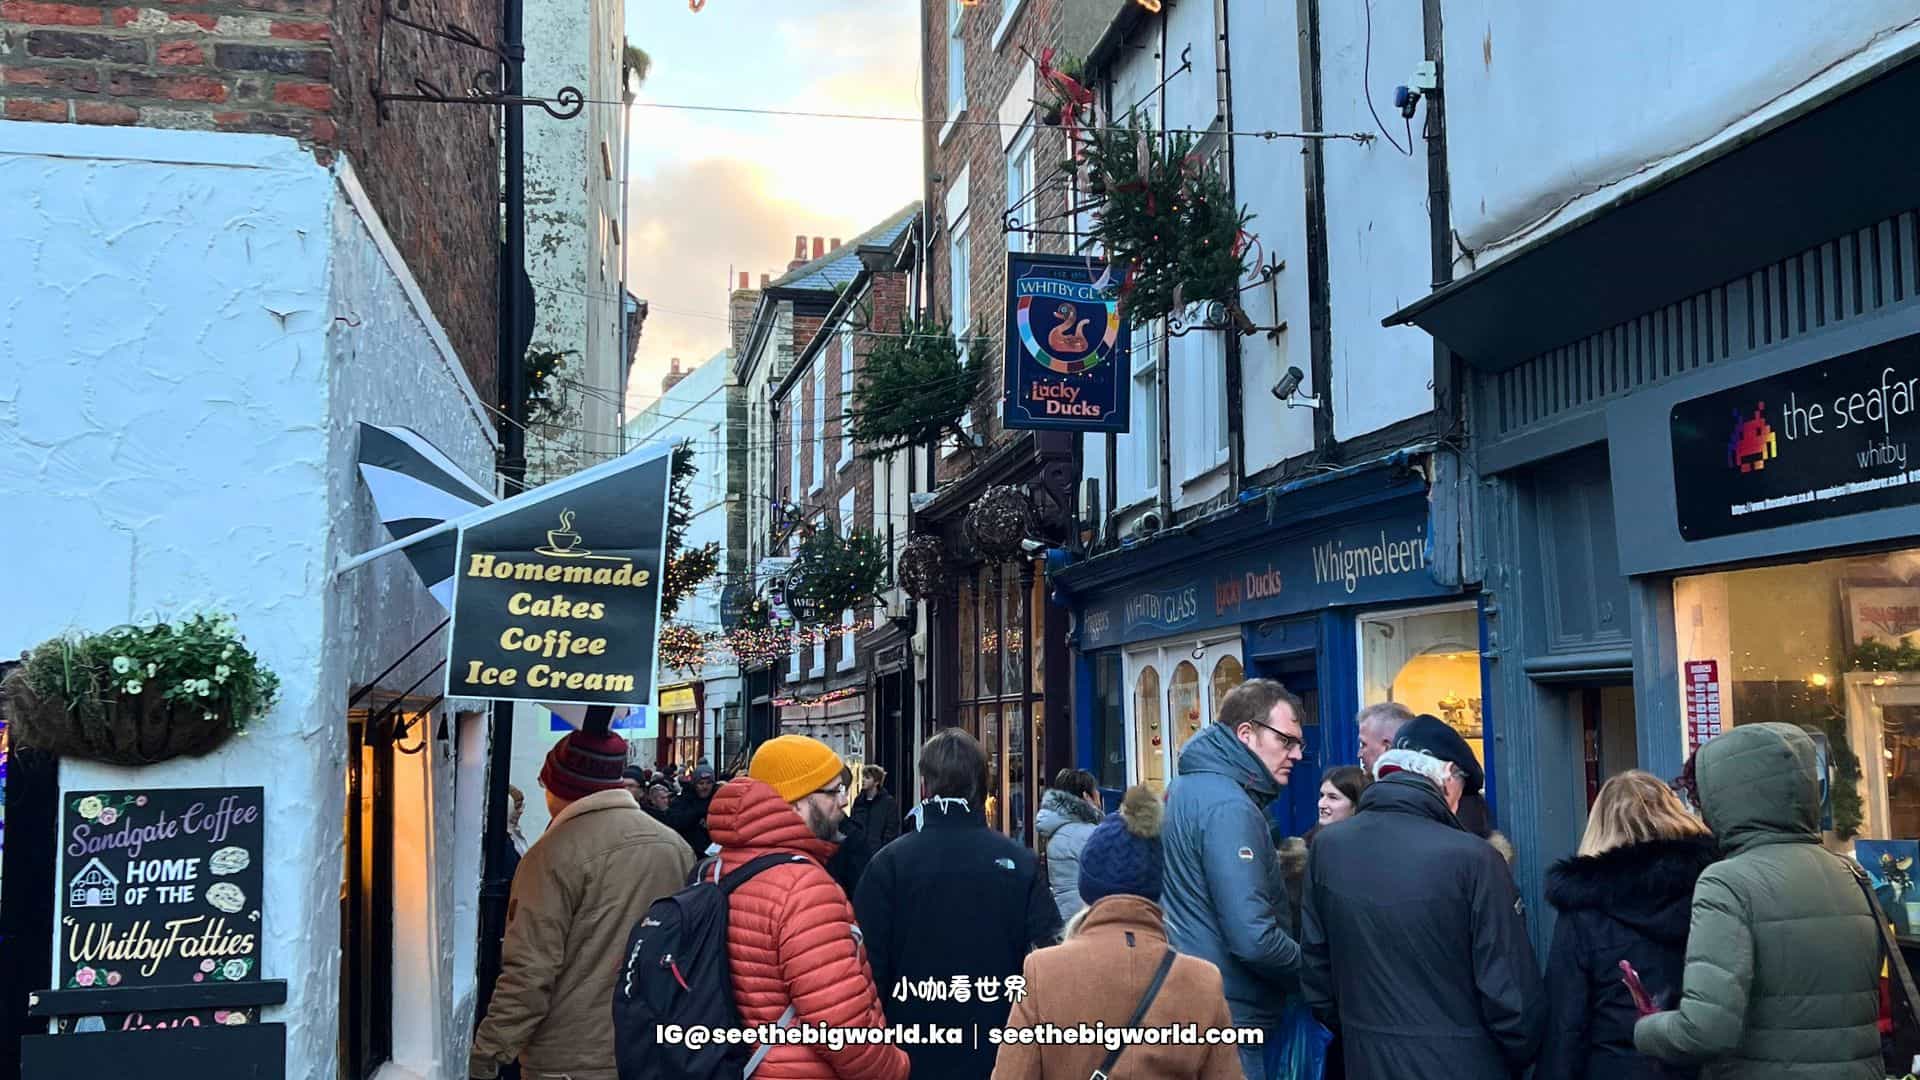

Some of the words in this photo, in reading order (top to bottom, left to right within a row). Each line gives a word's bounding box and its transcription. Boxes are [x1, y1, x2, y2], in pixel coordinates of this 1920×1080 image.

[1021, 281, 1074, 297] WHITBY
[1032, 381, 1080, 403] Lucky
[1046, 399, 1101, 416] Ducks
[1783, 391, 1824, 440] the
[1856, 436, 1907, 469] whitby
[467, 554, 650, 587] Homemade
[1312, 524, 1428, 593] Whigmeleeri
[1246, 563, 1282, 600] Ducks
[508, 592, 605, 620] Cakes
[1126, 593, 1162, 625] WHITBY
[1164, 588, 1197, 624] GLASS
[500, 627, 607, 658] Coffee
[465, 661, 518, 686] Ice
[526, 664, 634, 692] Cream
[68, 810, 178, 858] Sandgate
[180, 796, 258, 843] Coffee
[127, 858, 200, 884] HOME
[125, 887, 150, 905] OF
[156, 885, 195, 904] THE
